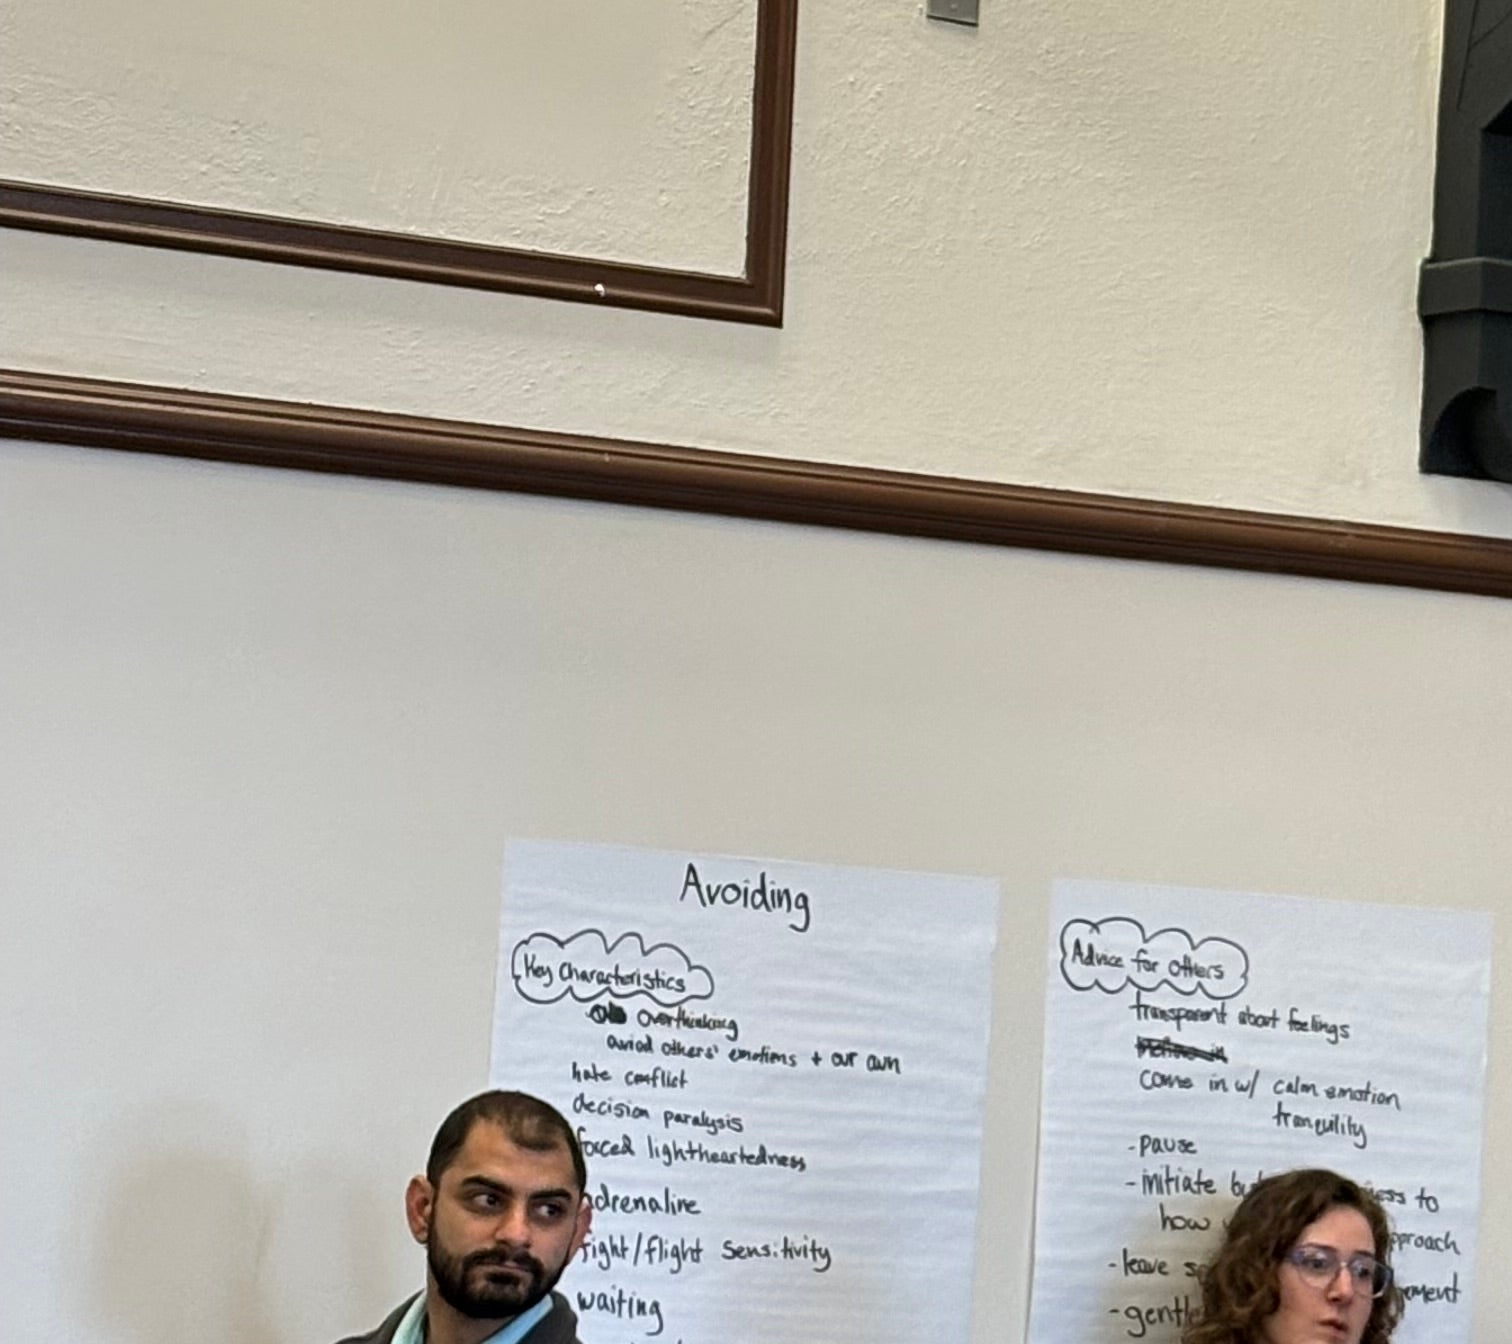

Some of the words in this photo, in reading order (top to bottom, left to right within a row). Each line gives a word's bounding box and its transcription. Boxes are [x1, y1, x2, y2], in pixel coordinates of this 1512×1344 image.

[680, 862, 812, 932] Avoiding
[523, 952, 553, 988] Key
[559, 962, 686, 993] Characteristics
[1072, 938, 1125, 969] Advice
[1130, 948, 1159, 972] for
[1129, 990, 1228, 1032] transparent
[1238, 1004, 1281, 1029] about
[1287, 1007, 1351, 1045] feelings
[571, 1061, 612, 1084] hate
[624, 1066, 690, 1090] conflict
[1209, 1073, 1229, 1093] in
[1234, 1069, 1260, 1100] w/
[1324, 1080, 1402, 1111] emotion
[572, 1093, 650, 1119] decision
[664, 1110, 744, 1134] paralysis
[1159, 1202, 1211, 1231] how
[1415, 1186, 1440, 1214] to
[577, 1284, 664, 1336] waiting
